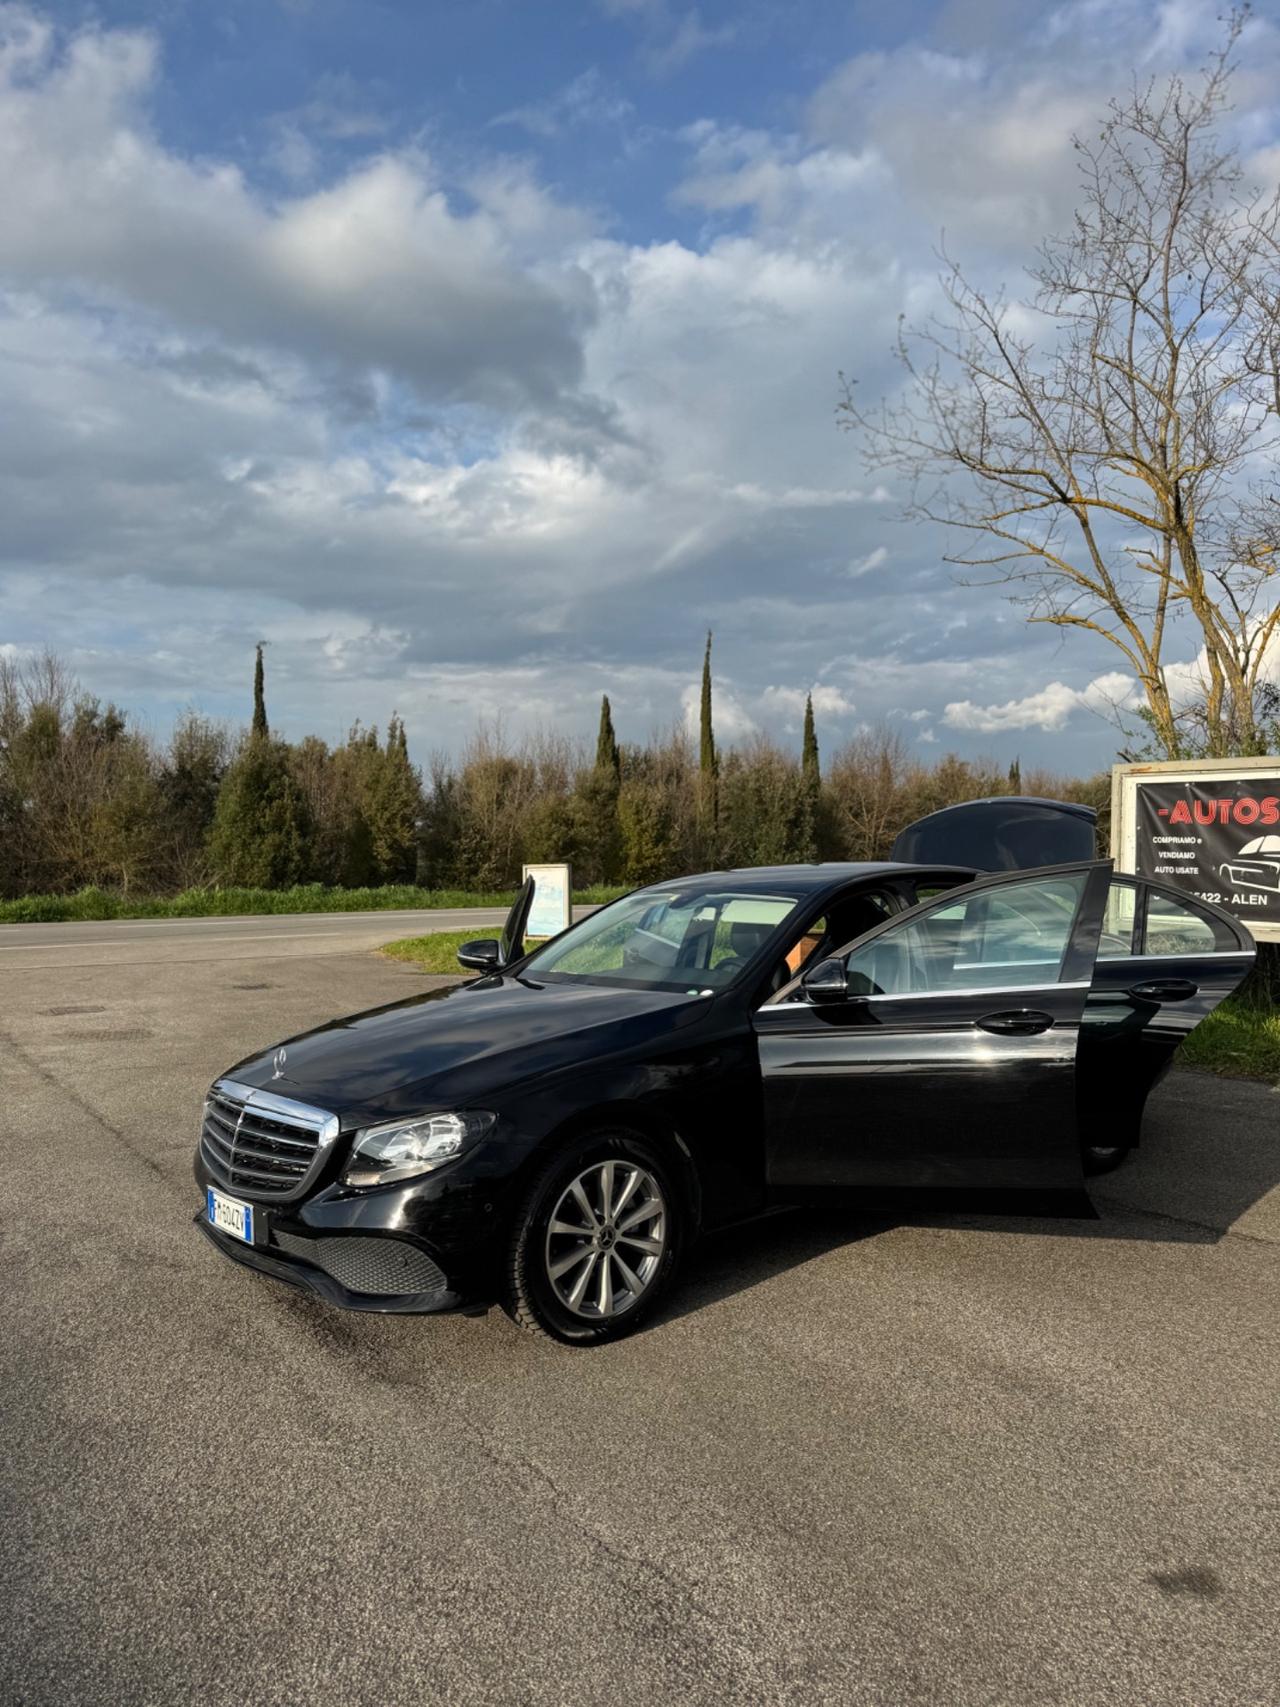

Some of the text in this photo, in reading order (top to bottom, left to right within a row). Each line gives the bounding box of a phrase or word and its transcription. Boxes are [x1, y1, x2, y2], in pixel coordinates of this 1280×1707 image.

[1152, 836, 1196, 844] COMPRIAMO
[1158, 851, 1196, 859] VENDIAMO
[1154, 866, 1199, 875] AUTO USATE
[1231, 894, 1268, 905] ALEN
